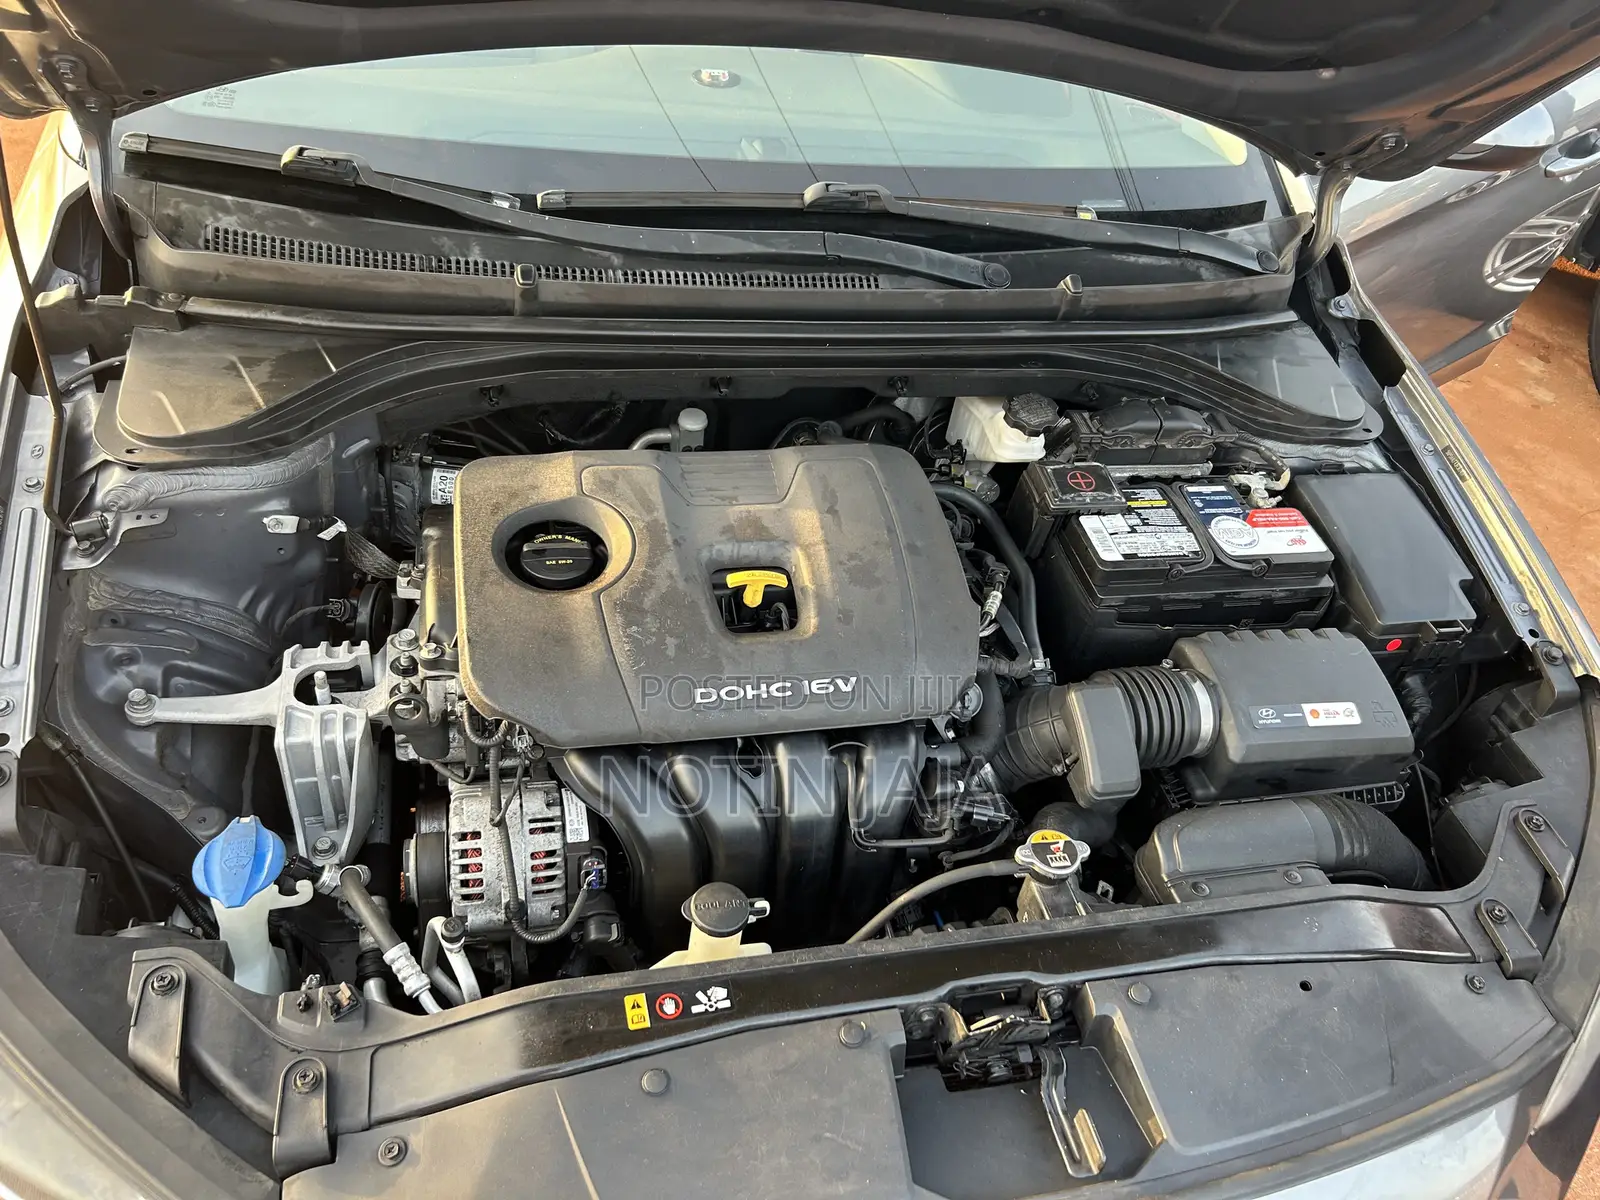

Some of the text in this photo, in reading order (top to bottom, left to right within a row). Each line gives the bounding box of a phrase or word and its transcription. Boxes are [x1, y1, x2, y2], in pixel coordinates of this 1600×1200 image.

[533, 534, 563, 544] OWNER'S
[693, 676, 858, 704] DOHC 16V
